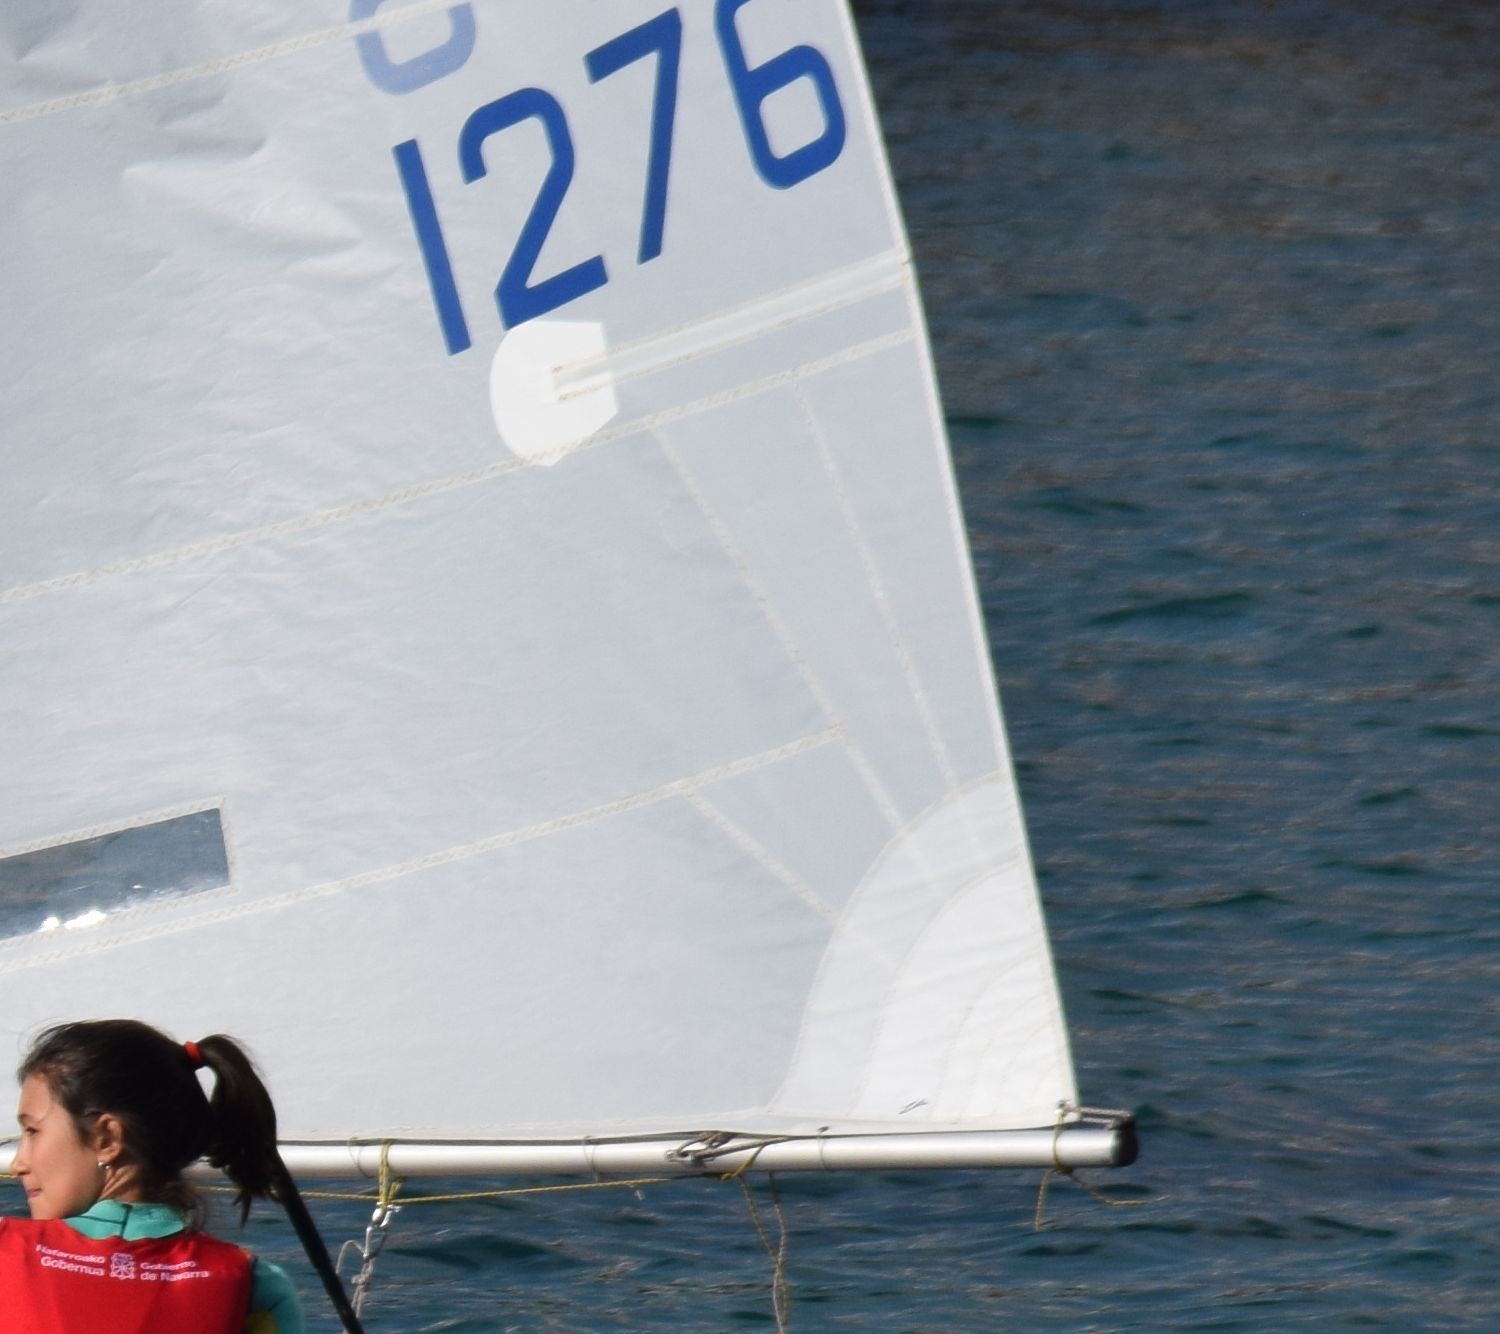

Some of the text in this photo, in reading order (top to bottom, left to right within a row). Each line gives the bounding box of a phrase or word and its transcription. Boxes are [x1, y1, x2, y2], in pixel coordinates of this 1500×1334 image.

[36, 1244, 106, 1264] Nafarroako
[40, 1256, 105, 1277] Gobernua
[140, 1270, 210, 1282] de Navarra
